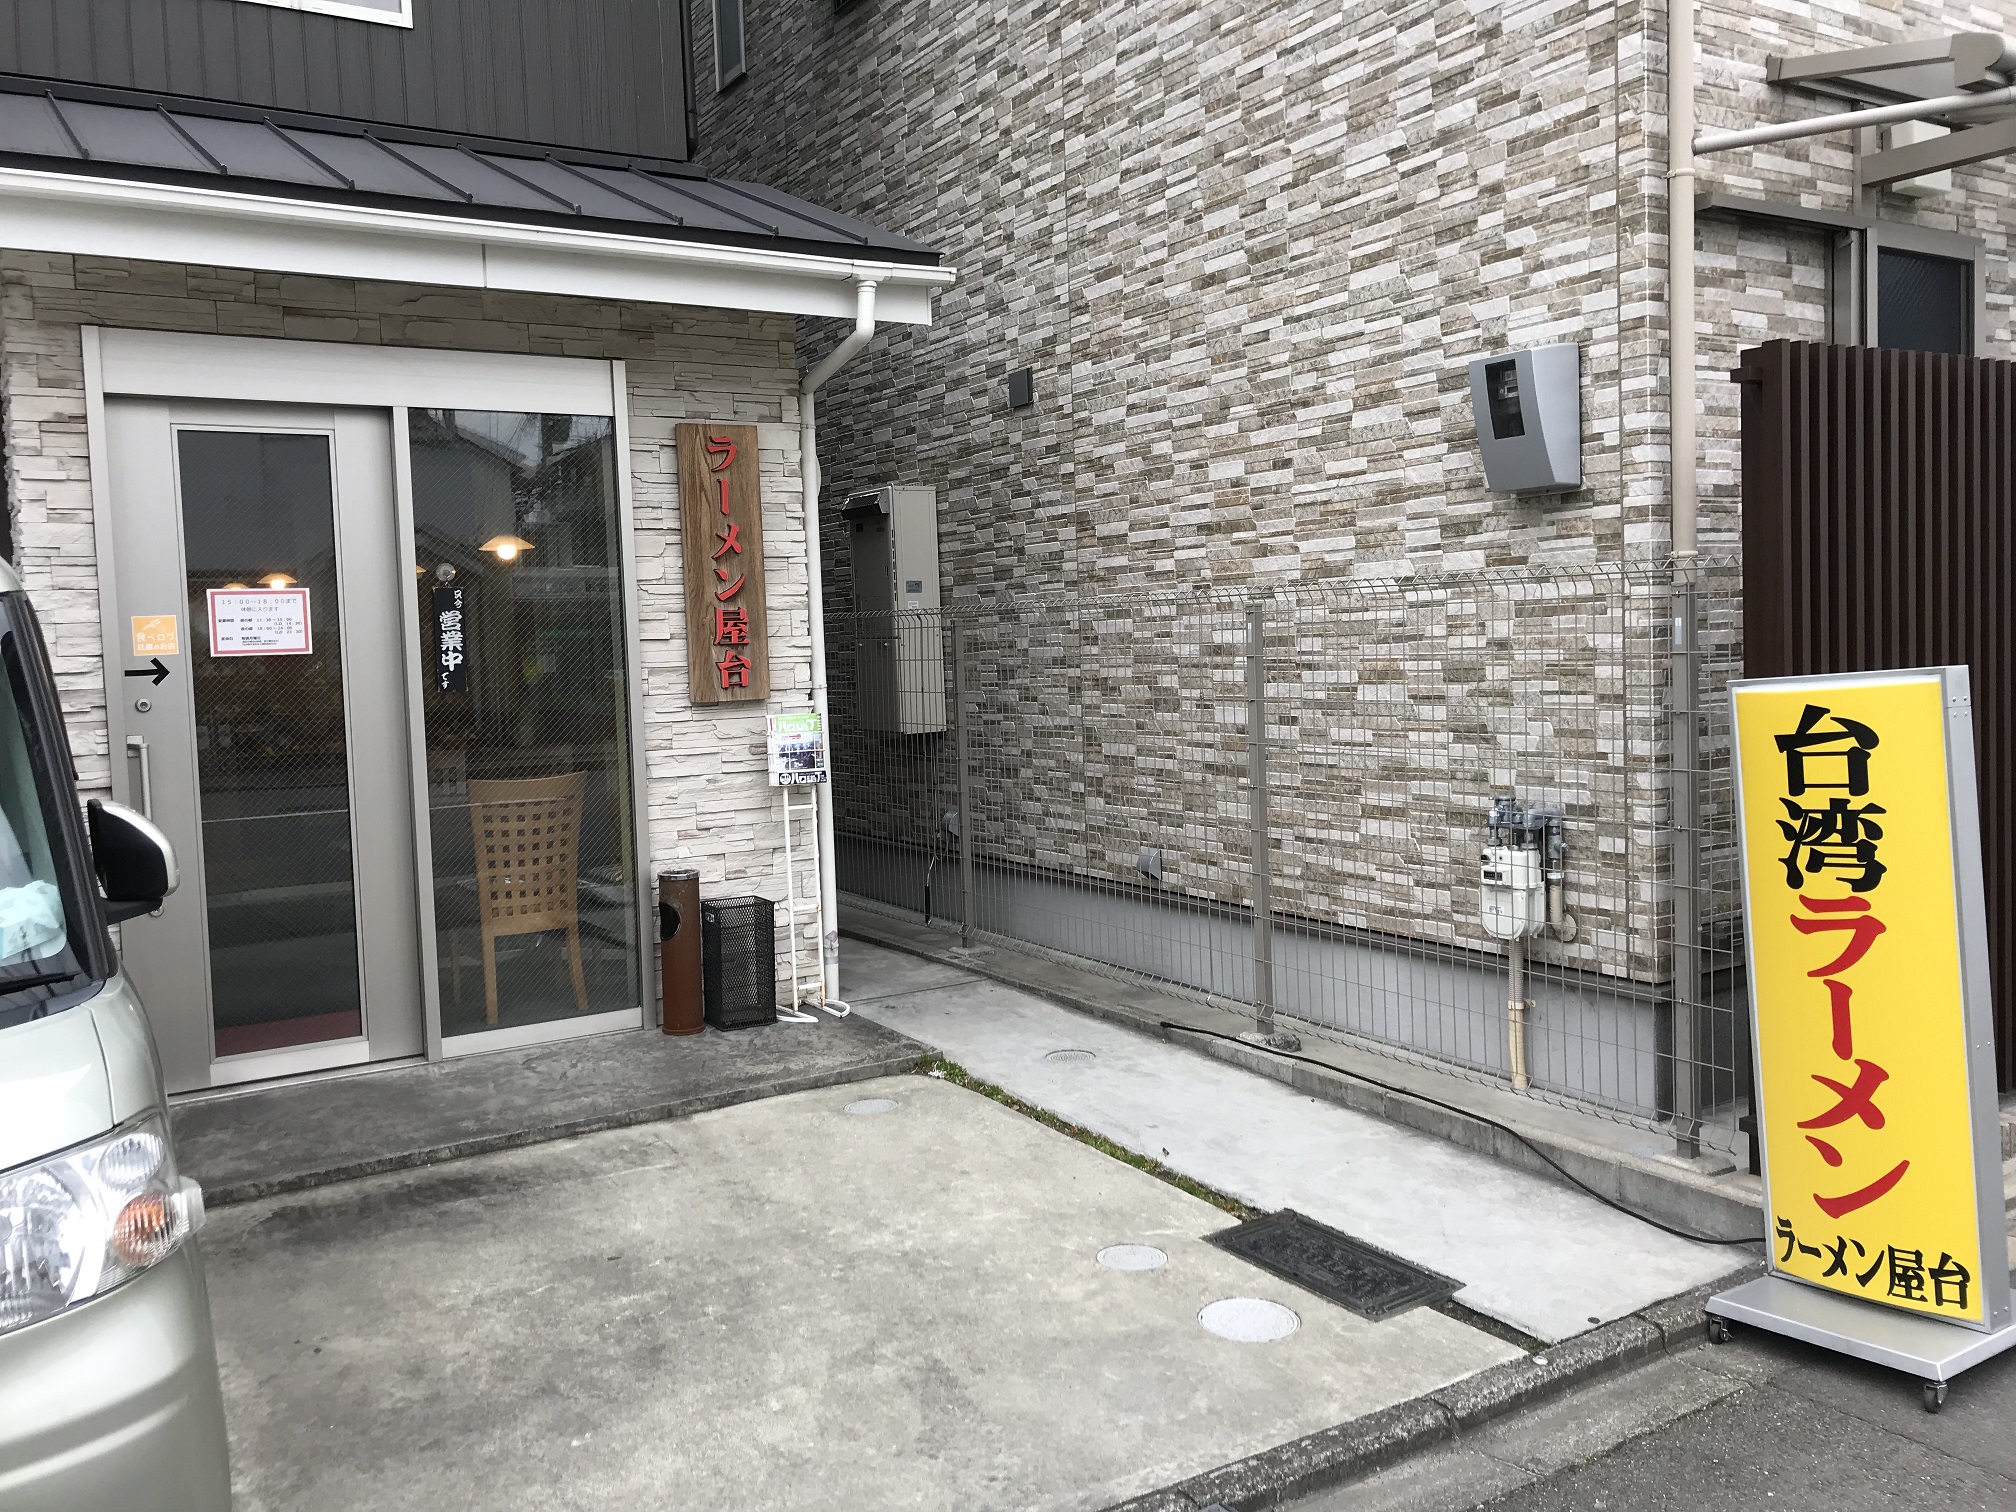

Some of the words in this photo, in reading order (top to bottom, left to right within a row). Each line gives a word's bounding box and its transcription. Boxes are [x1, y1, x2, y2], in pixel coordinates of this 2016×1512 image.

[705, 434, 752, 690] ラーメン屋台
[453, 589, 463, 609] 只今
[135, 632, 175, 643] 食べログ
[439, 610, 464, 672] 営業中
[440, 671, 450, 690] です
[1773, 703, 1911, 1221] 台湾ラーメン
[1774, 1215, 1971, 1311] ラーメン屋台
